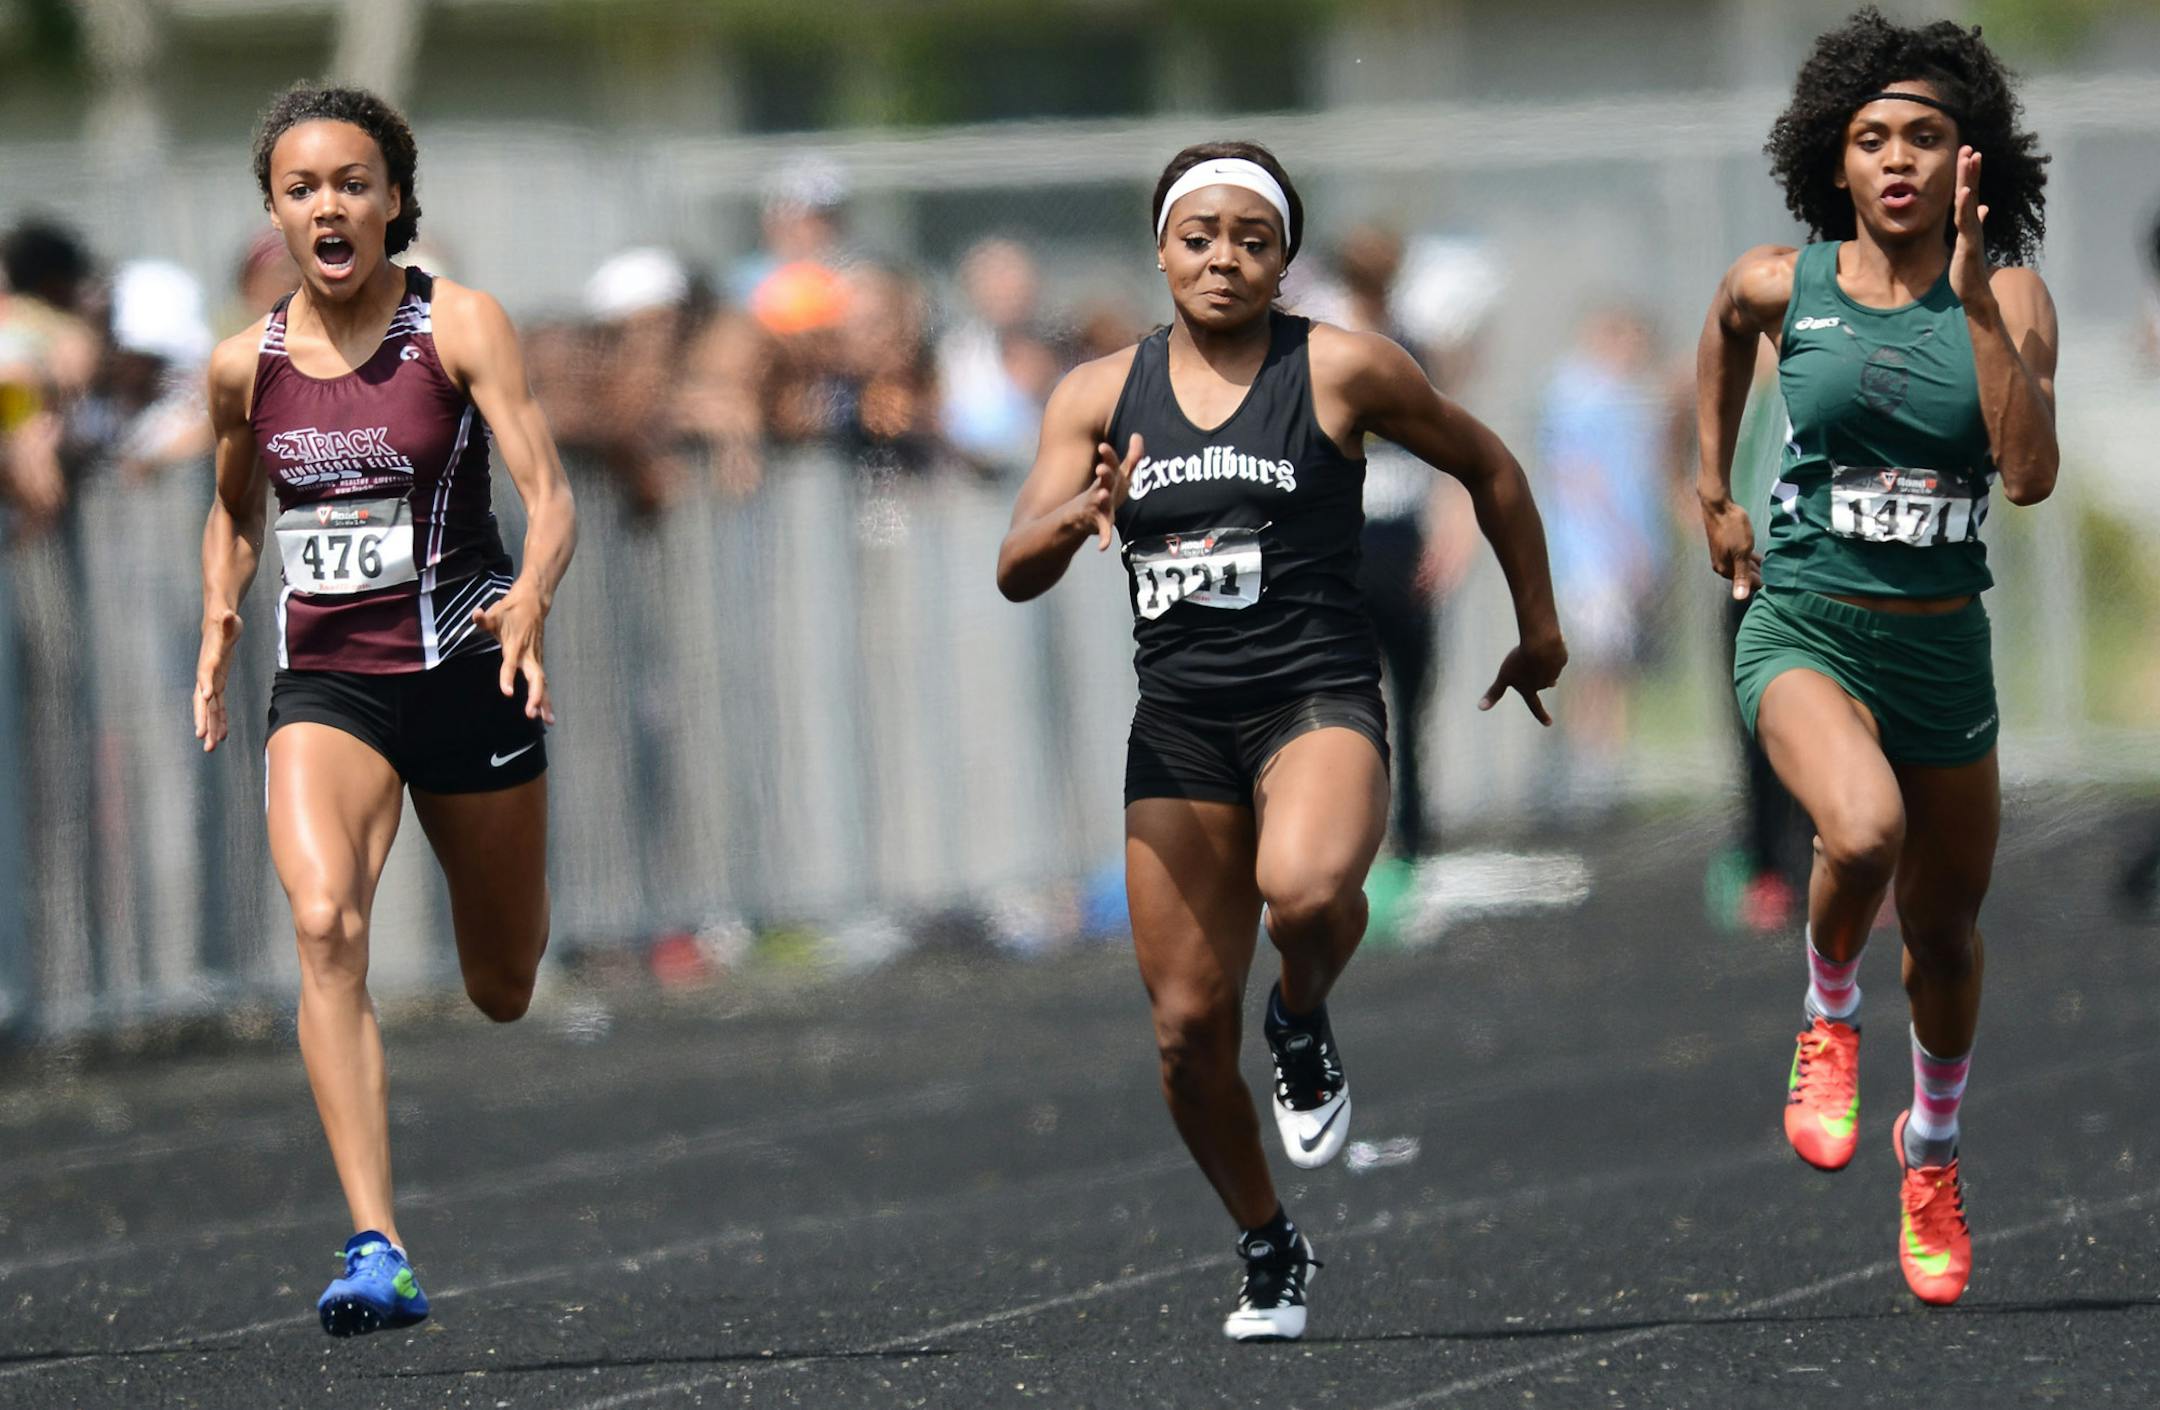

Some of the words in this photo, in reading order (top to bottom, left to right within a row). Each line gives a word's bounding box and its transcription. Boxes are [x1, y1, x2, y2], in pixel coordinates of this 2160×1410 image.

[280, 459, 363, 480] MINNESOTA
[366, 455, 413, 468] ELITE
[281, 427, 398, 464] TRACK
[1128, 446, 1297, 501] Excaliburs
[1848, 499, 1953, 545] 1471
[302, 533, 383, 580] 476
